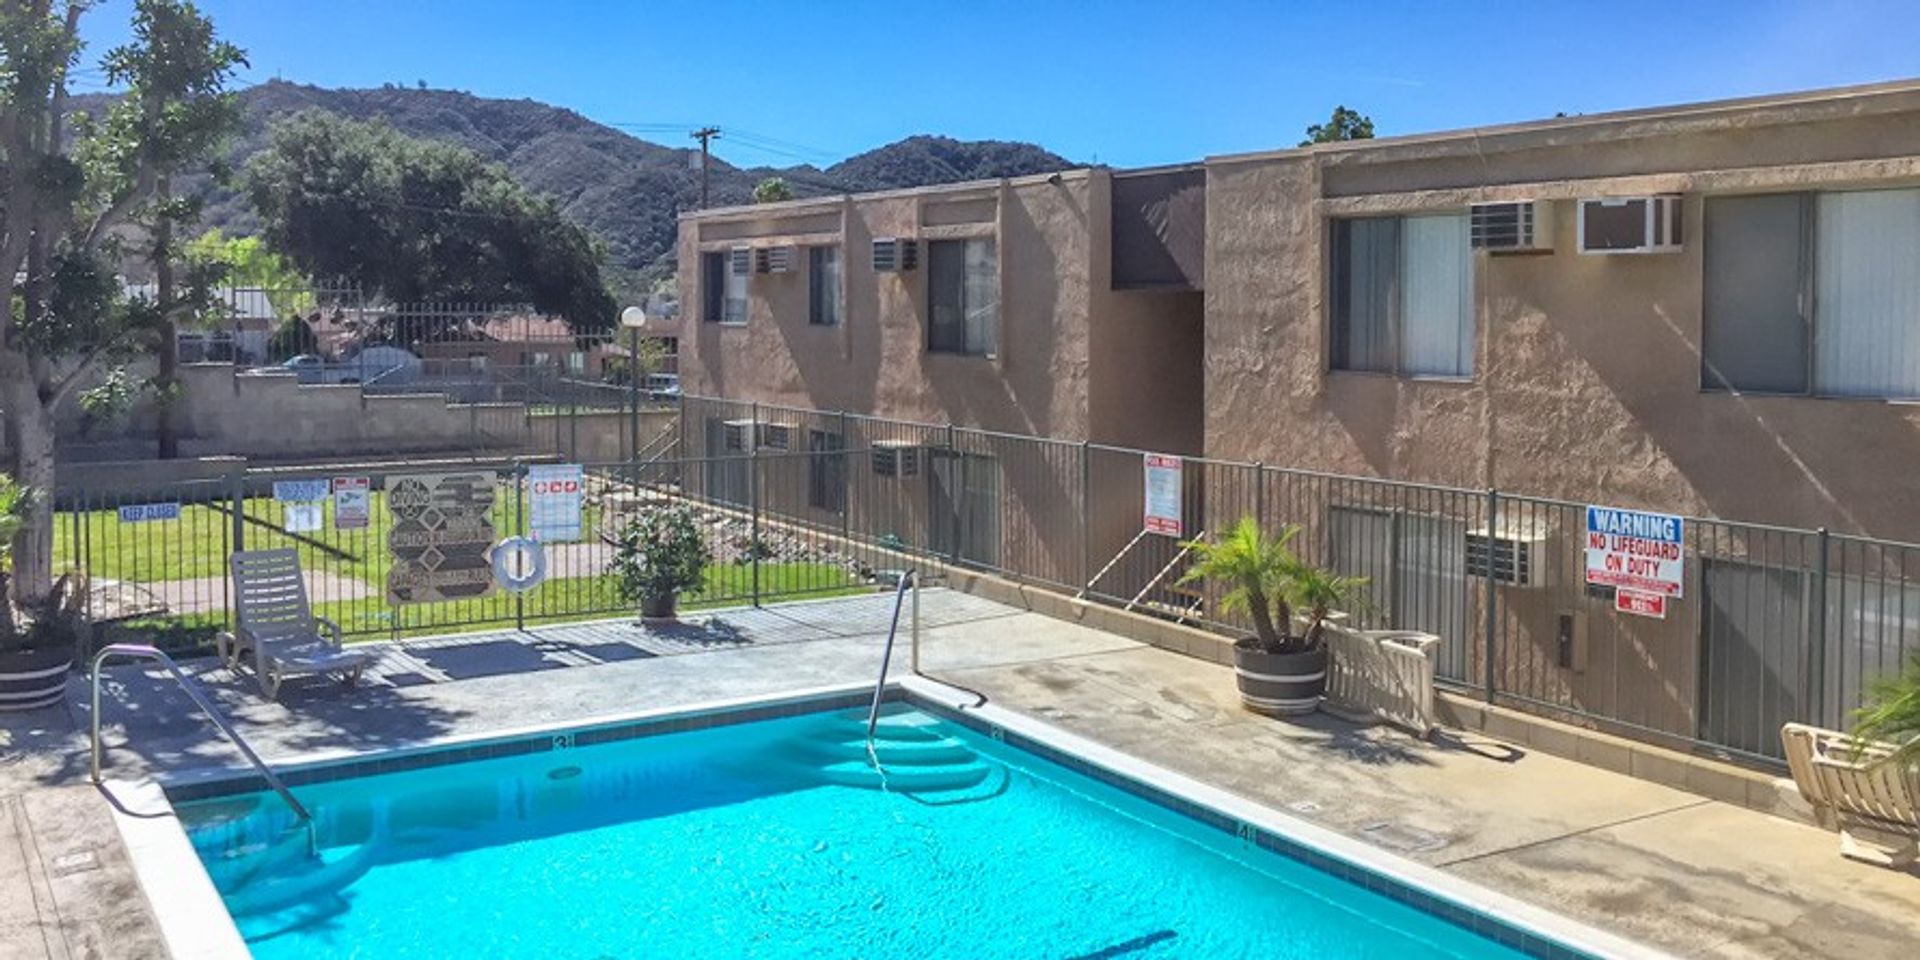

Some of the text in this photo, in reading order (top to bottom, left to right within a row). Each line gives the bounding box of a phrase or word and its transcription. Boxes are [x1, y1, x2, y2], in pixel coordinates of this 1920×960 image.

[123, 506, 143, 521] KEEP
[1594, 509, 1676, 540] WARNING
[1590, 533, 1680, 560] NO LIFEGUARD
[1605, 553, 1660, 577] ON DUTY
